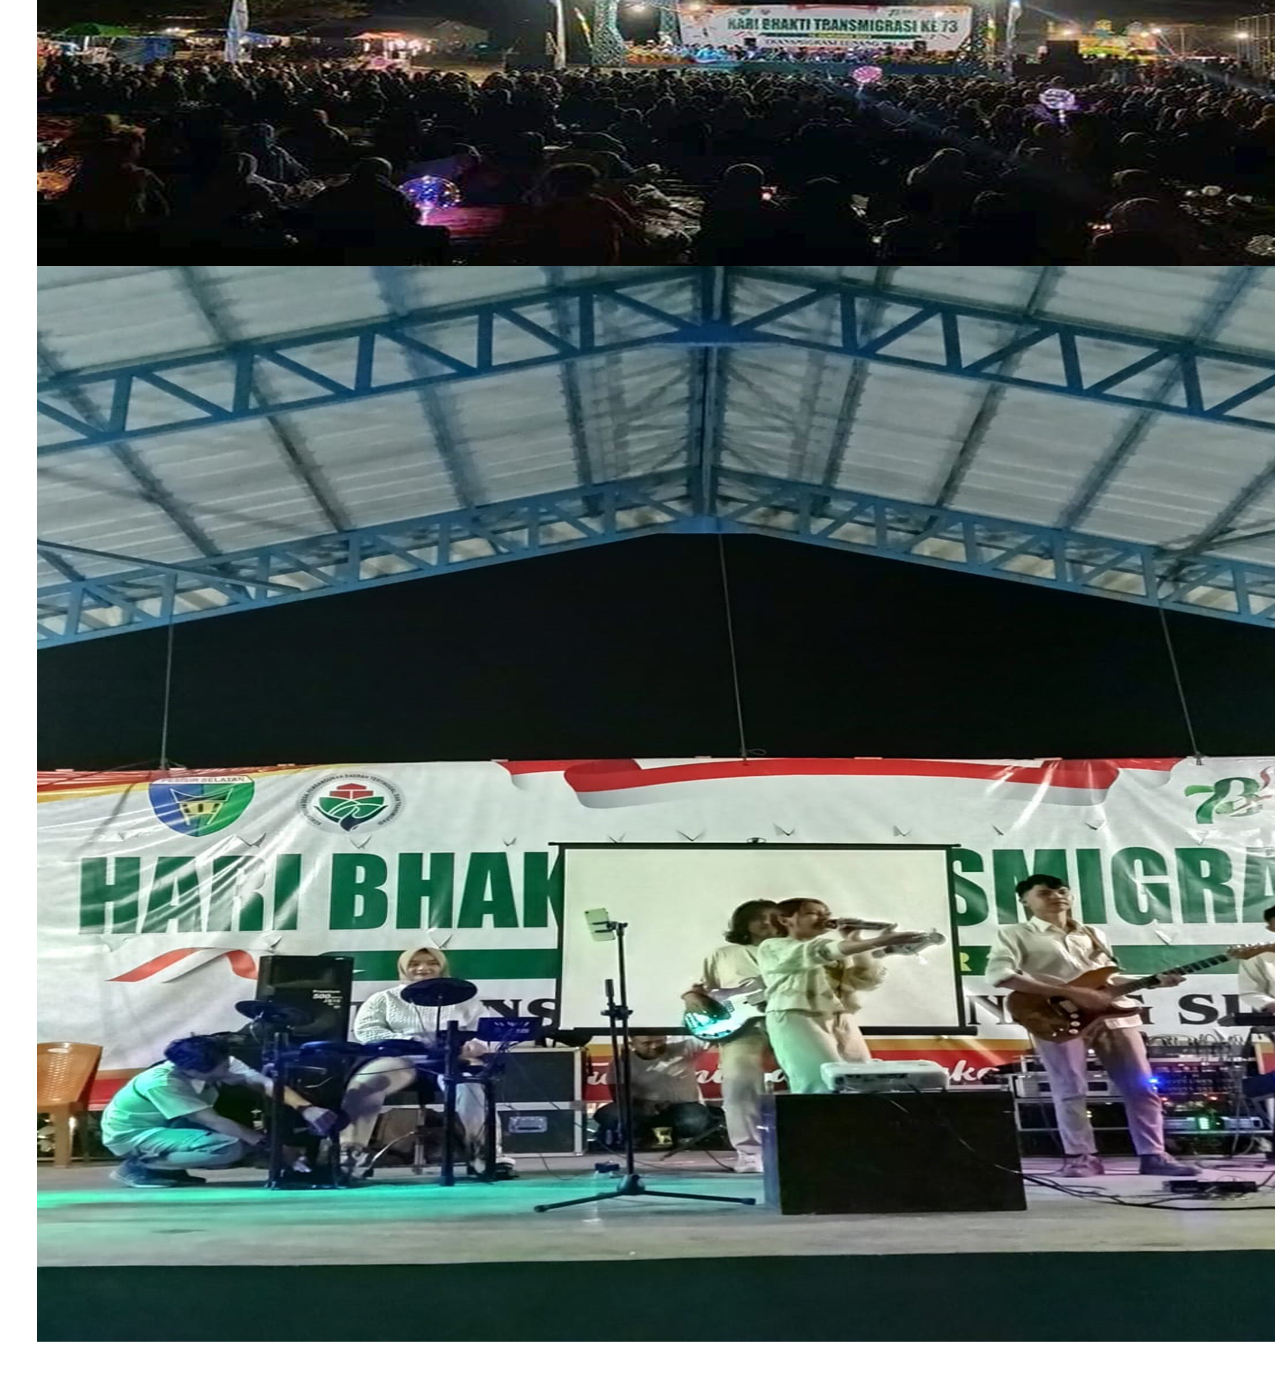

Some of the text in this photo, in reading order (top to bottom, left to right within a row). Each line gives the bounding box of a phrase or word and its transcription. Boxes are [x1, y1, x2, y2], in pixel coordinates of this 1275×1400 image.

[814, 18, 917, 32] TRANSMIGRASI
[941, 20, 958, 34] 73
[79, 853, 301, 934] HARI
[329, 850, 563, 931] BHAK
